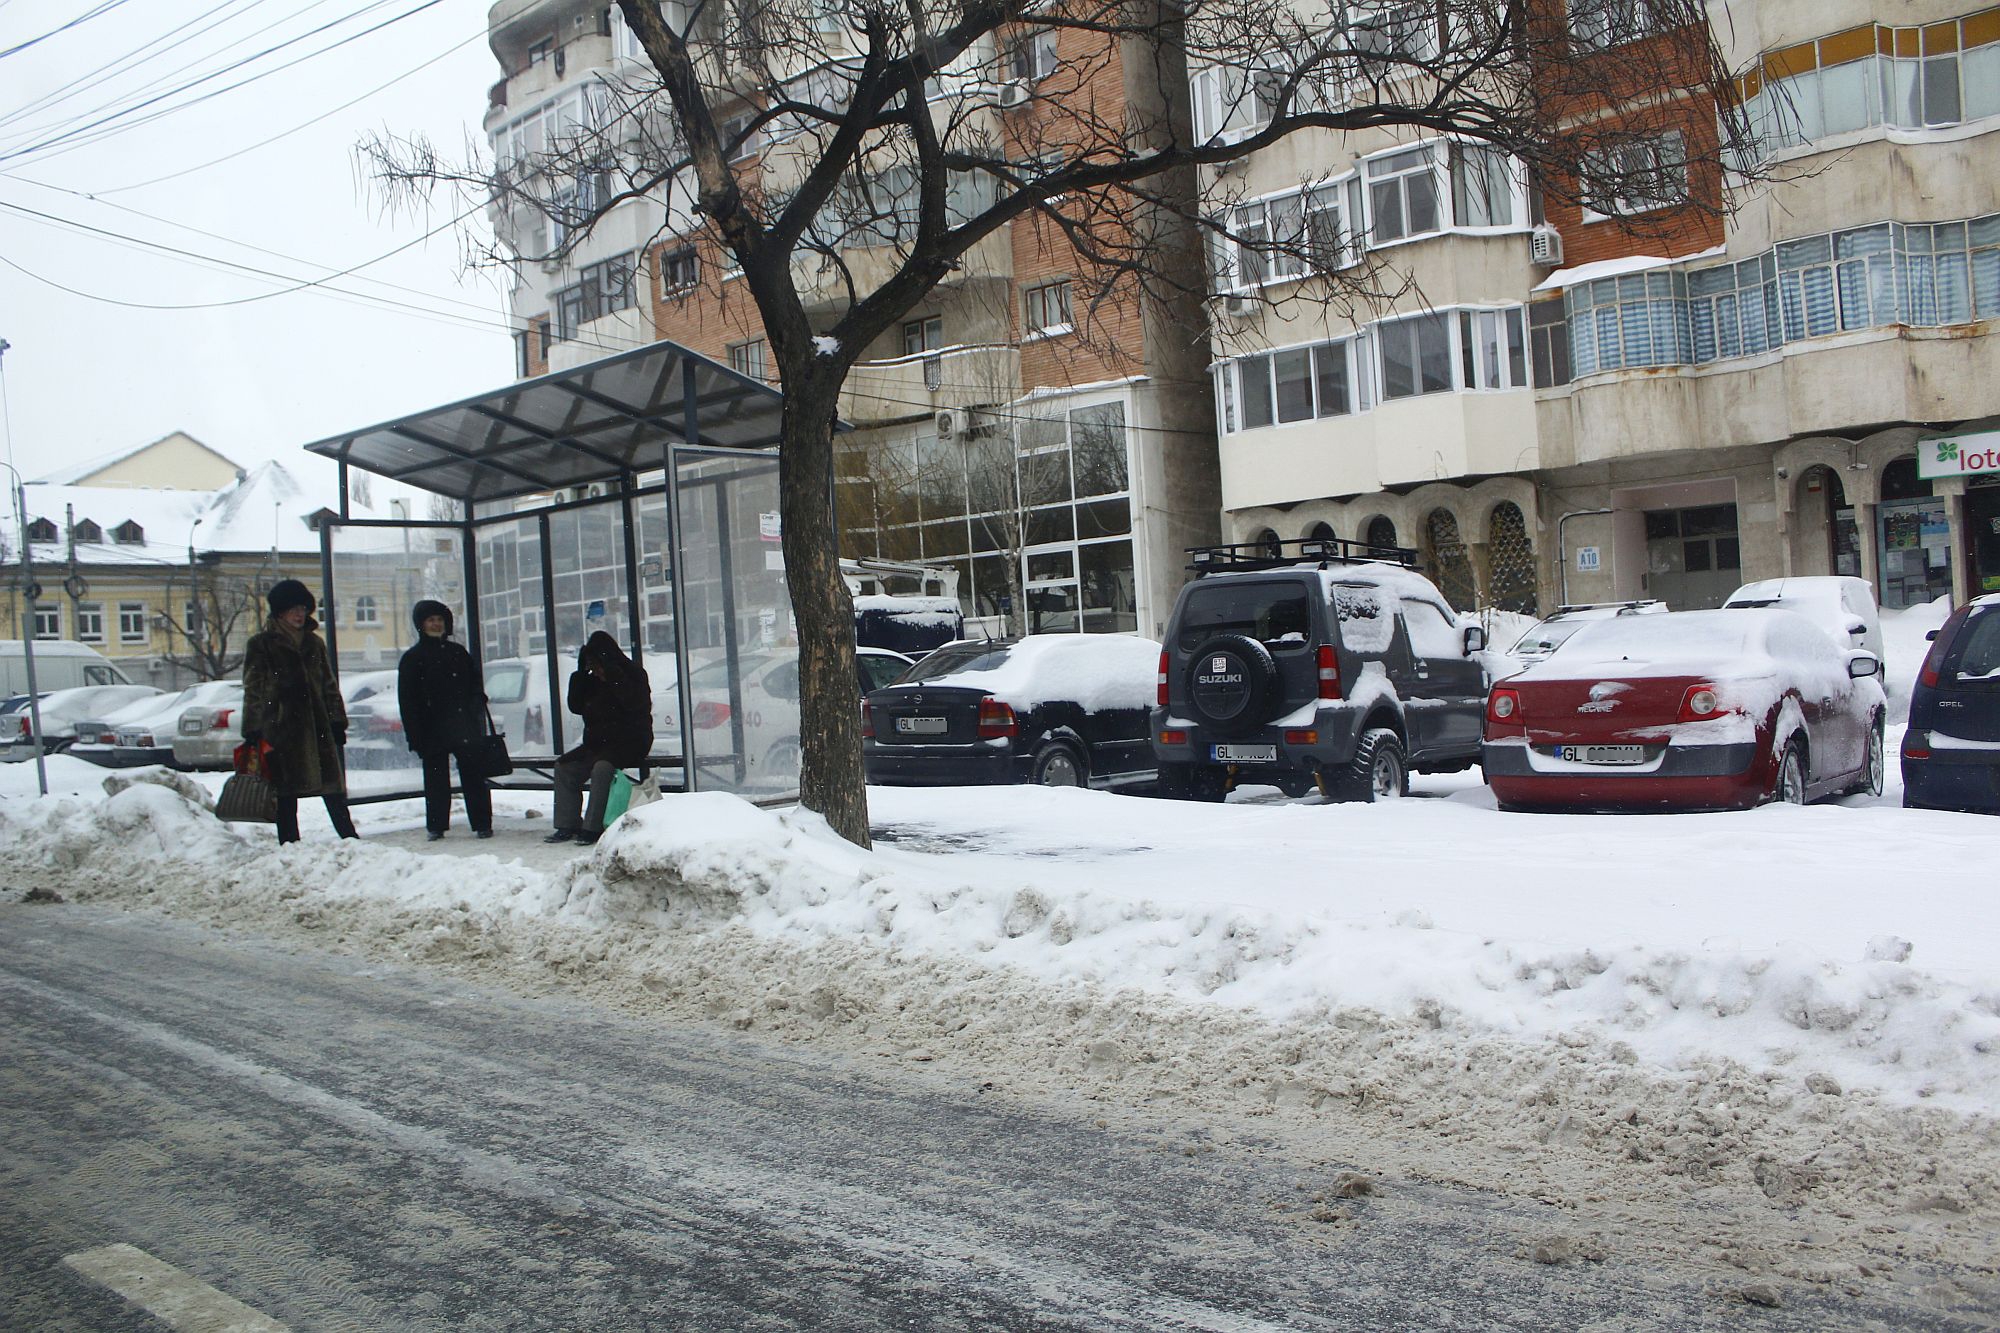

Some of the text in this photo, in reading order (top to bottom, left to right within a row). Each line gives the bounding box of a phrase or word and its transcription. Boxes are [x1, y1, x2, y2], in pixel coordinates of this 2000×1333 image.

[1960, 448, 2000, 470] lot
[1581, 553, 1597, 565] A10
[1199, 674, 1242, 683] SUZUKI
[901, 719, 911, 729] GL
[1217, 746, 1232, 759] GL
[1563, 747, 1582, 761] GL
